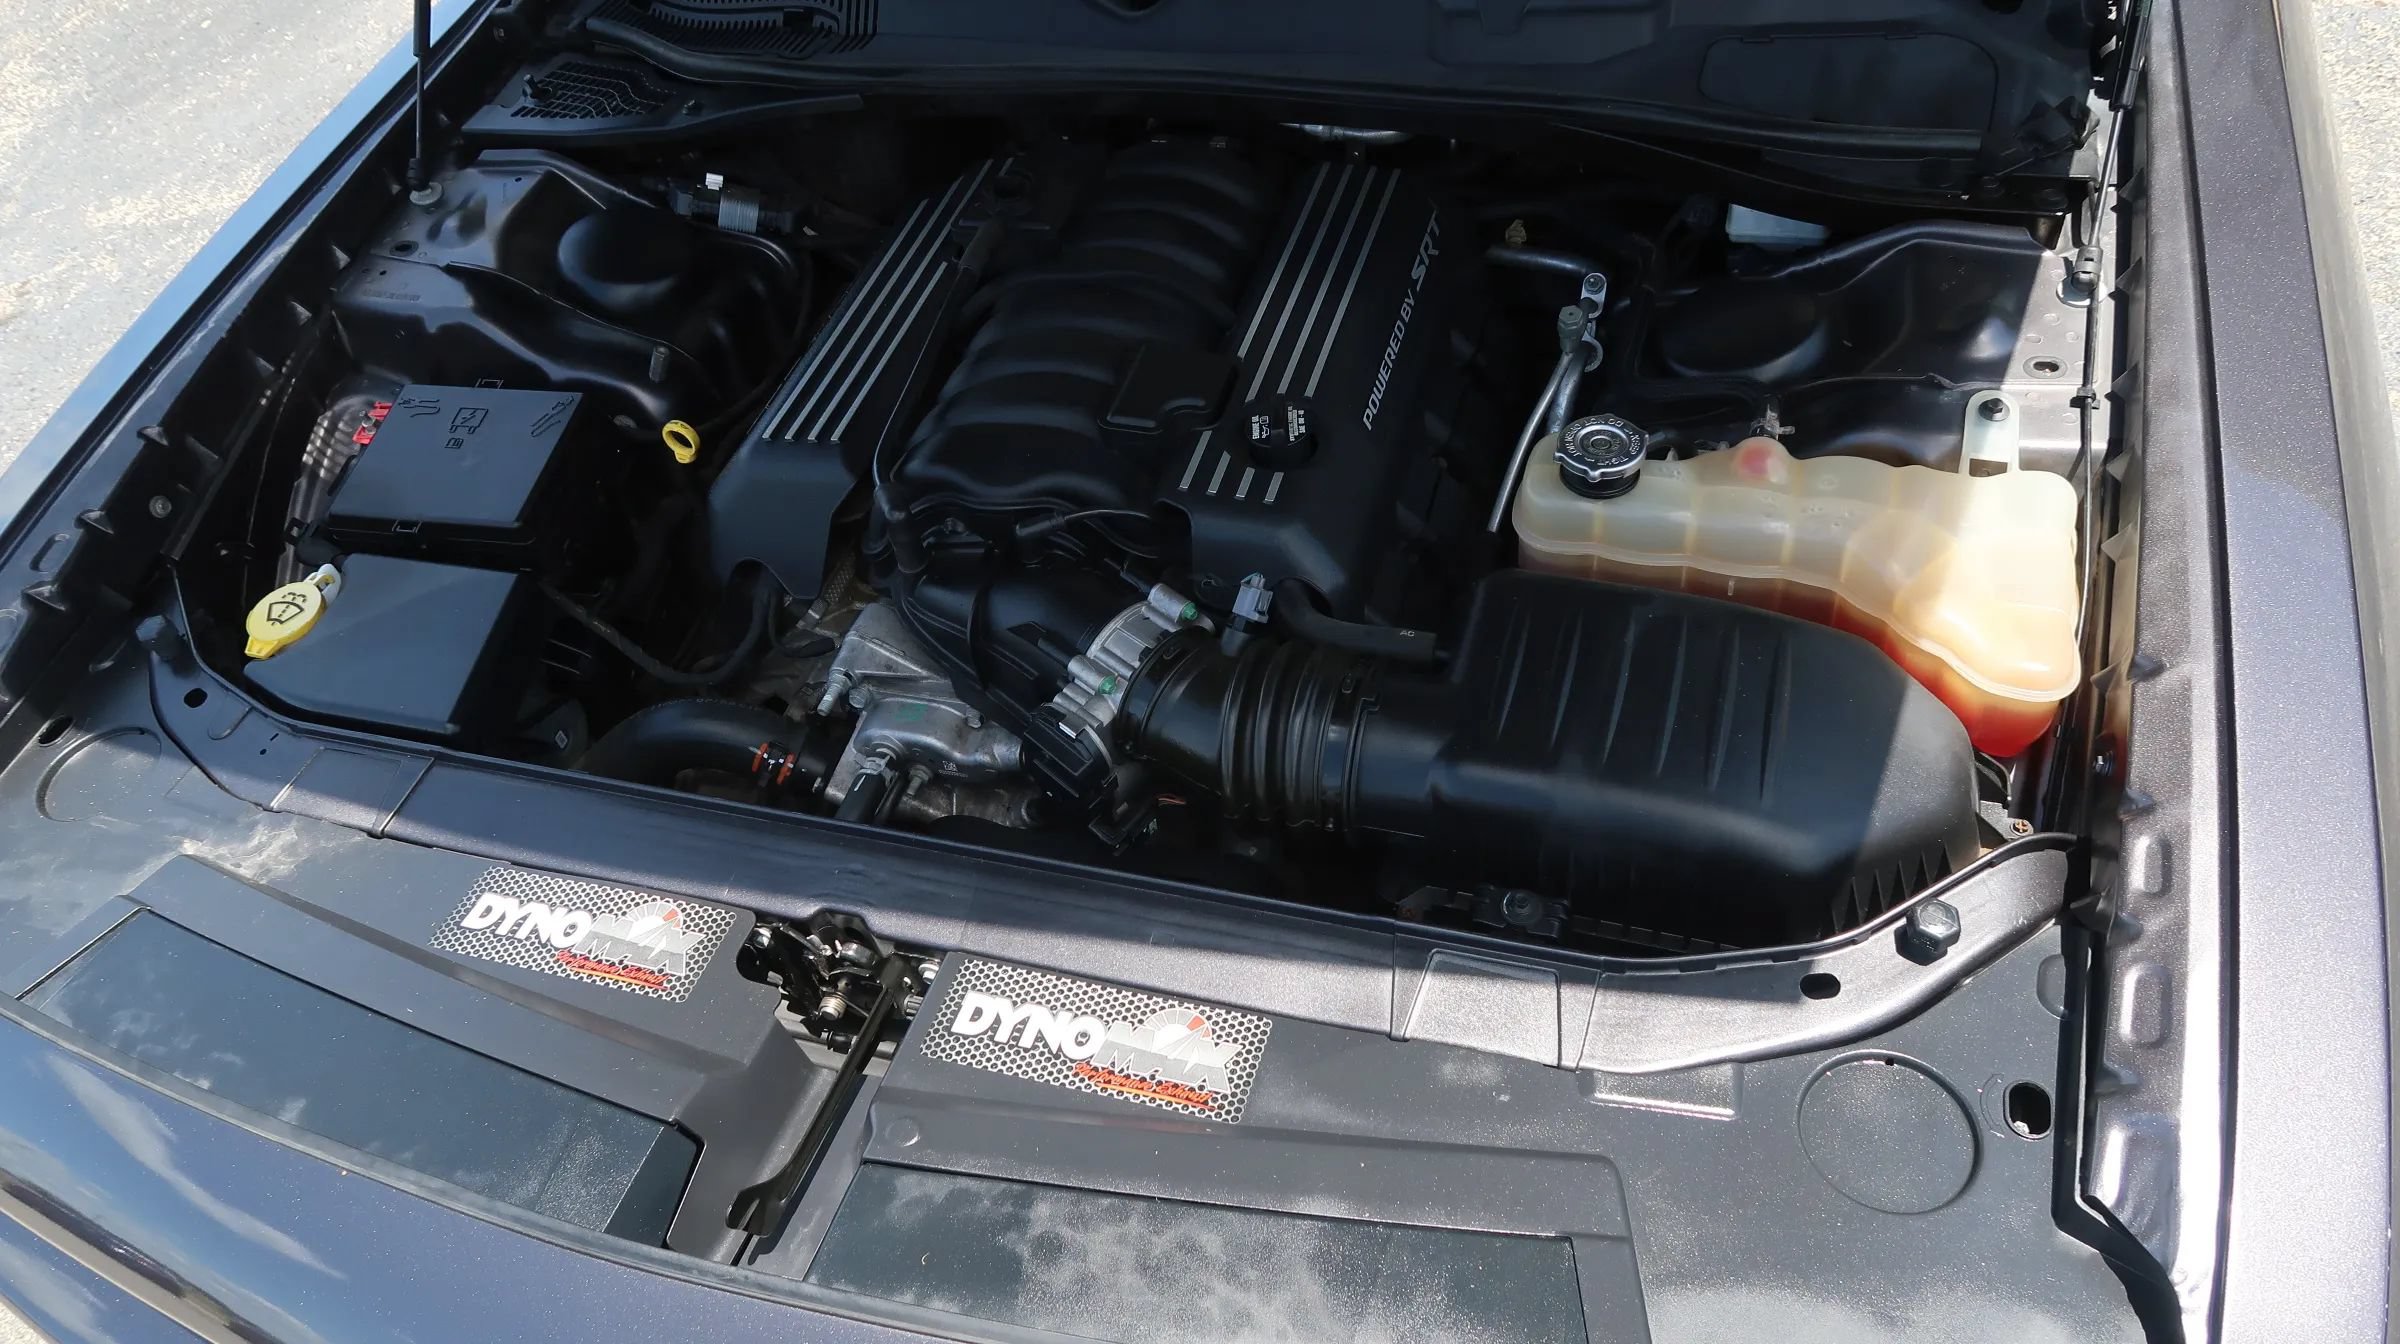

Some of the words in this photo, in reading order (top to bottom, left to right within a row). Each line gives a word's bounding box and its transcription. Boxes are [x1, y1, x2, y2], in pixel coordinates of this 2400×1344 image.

[1363, 319, 1405, 431] POWERED
[1400, 288, 1415, 323] BY
[1411, 209, 1440, 292] SRT
[1584, 417, 1604, 427] NOT
[1608, 418, 1624, 428] DO
